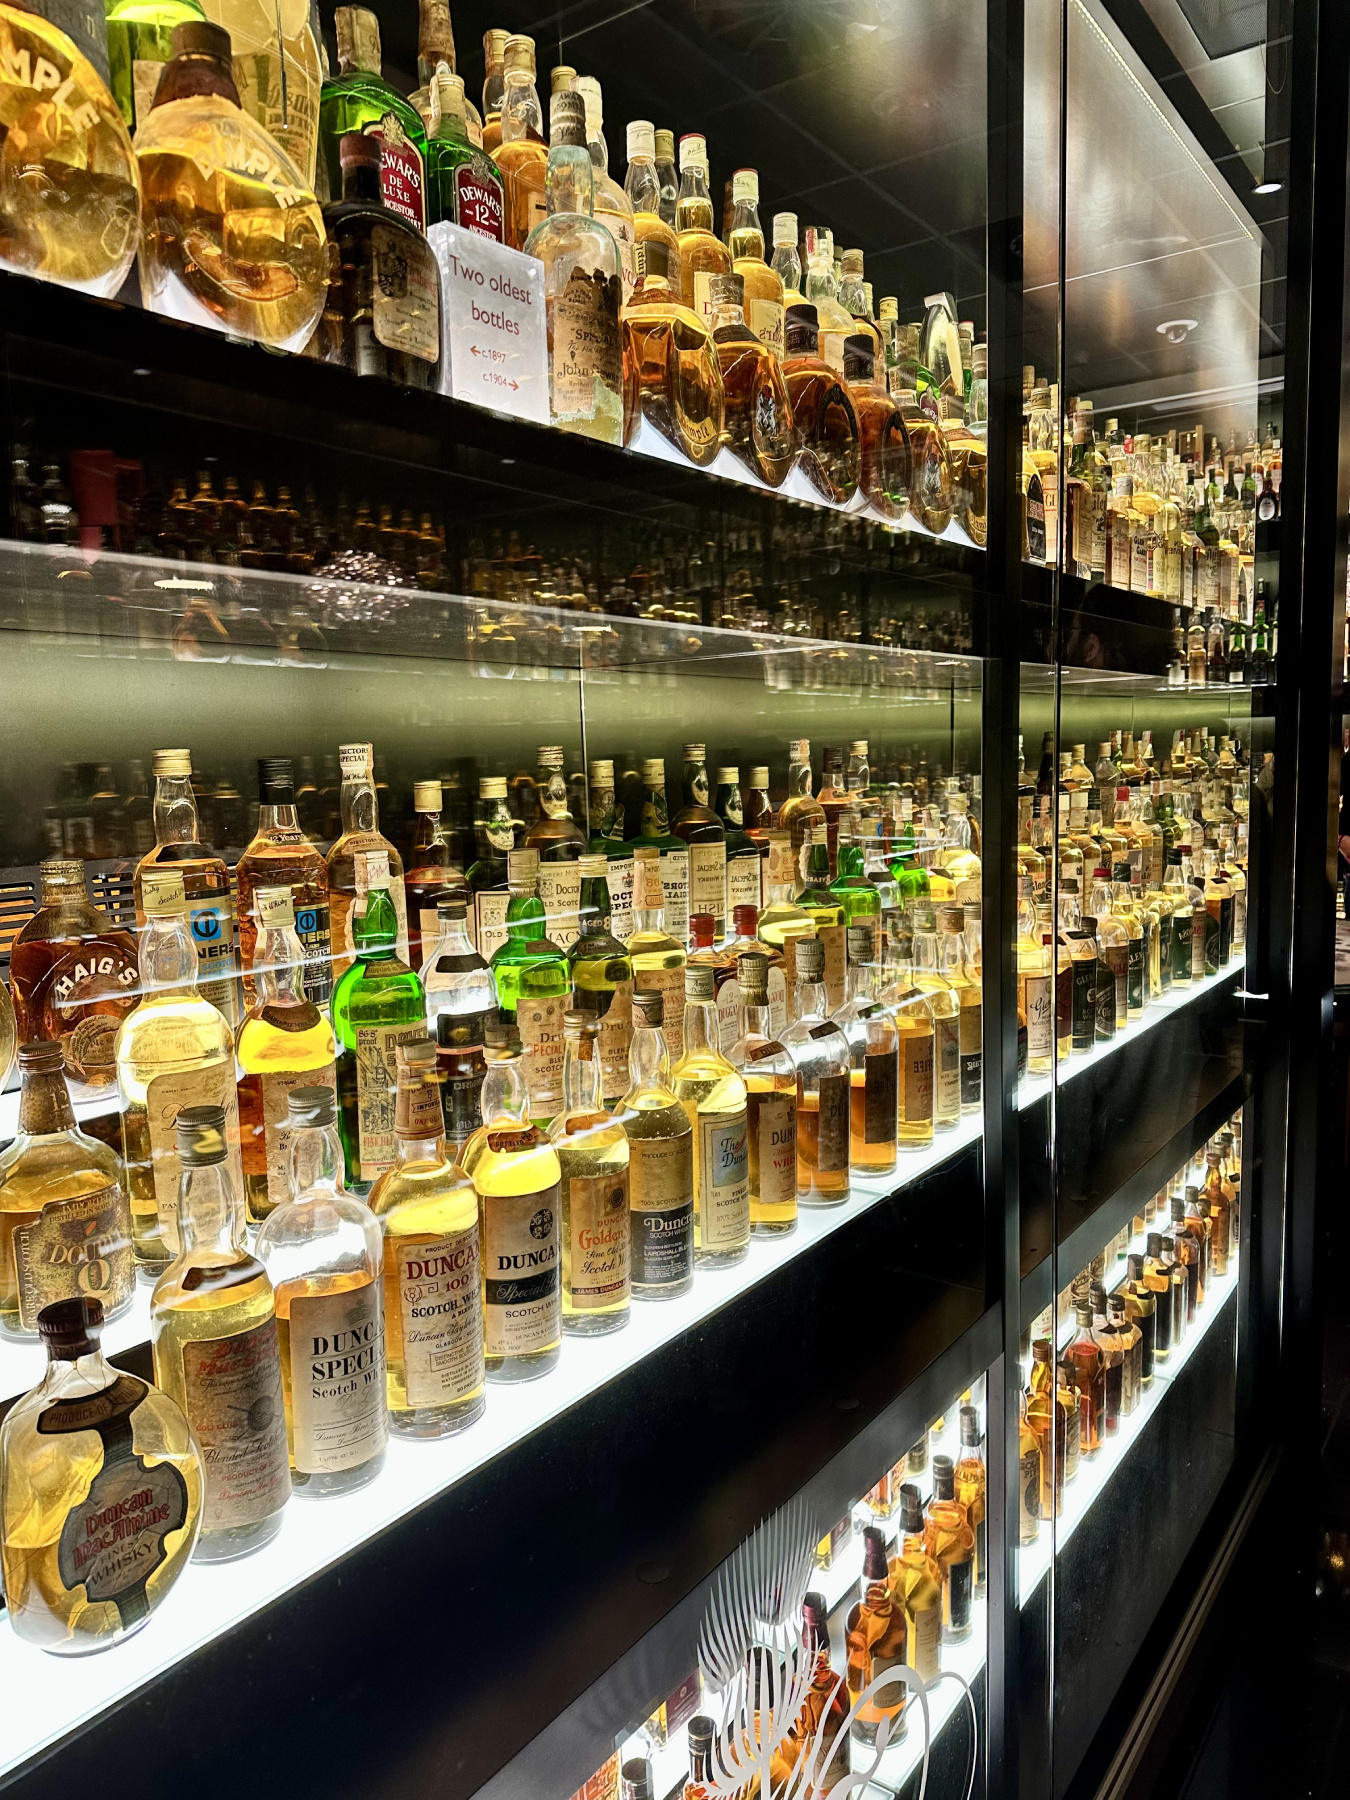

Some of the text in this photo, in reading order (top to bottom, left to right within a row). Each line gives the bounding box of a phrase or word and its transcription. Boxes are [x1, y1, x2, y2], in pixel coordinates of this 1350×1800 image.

[380, 152, 421, 194] EWAR'S.
[389, 174, 404, 188] DE
[382, 185, 411, 203] LUXE
[384, 198, 418, 220] NCESTOR.
[475, 203, 490, 226] 12
[450, 254, 486, 286] Two
[489, 274, 533, 306] oldest
[471, 300, 521, 336] bottles
[482, 345, 507, 364] c.1897
[557, 363, 590, 379] John
[482, 372, 507, 387] c.1904
[610, 891, 633, 901] OCT
[603, 915, 612, 931] 8
[485, 930, 503, 939] OLD
[55, 957, 139, 997] HAIG'S
[358, 1036, 378, 1047] proof
[540, 1032, 564, 1043] Dru
[601, 1055, 622, 1063] COTCH
[720, 1137, 739, 1153] The
[641, 1151, 668, 1160] PRODUCE
[772, 1156, 796, 1170] WHIS
[656, 1197, 678, 1206] SCOTCH
[716, 1197, 741, 1208] SCOTCH
[50, 1208, 86, 1223] DISTILLED
[578, 1227, 626, 1251] Golden
[649, 1231, 674, 1240] SCOTCH
[425, 1242, 453, 1254] PRODUCT
[586, 1249, 605, 1261] Fine
[580, 1258, 616, 1275] Scotch
[78, 1258, 113, 1299] Q
[496, 1280, 545, 1303] Special
[574, 1286, 599, 1296] JAMES
[411, 1299, 460, 1319] SCOTCH
[451, 1303, 474, 1320] A BLEND
[505, 1297, 557, 1319] SCOTCH WH
[311, 1320, 378, 1356] DUNC
[407, 1329, 446, 1344] Duncan
[435, 1335, 463, 1350] GLASGOW
[515, 1331, 540, 1341] DUNCAN
[311, 1344, 378, 1381] SPECI
[434, 1348, 465, 1362] DISTINCTIVE
[435, 1355, 458, 1367] SMOOTH
[312, 1367, 380, 1399] Scotch Wh
[48, 1402, 110, 1425] PRODUCE OF
[217, 1420, 238, 1431] CLUB
[203, 1442, 250, 1465] Blended
[221, 1467, 259, 1482] PRODUCT
[86, 1487, 154, 1538] Duncan
[90, 1539, 155, 1586] WHISKY
